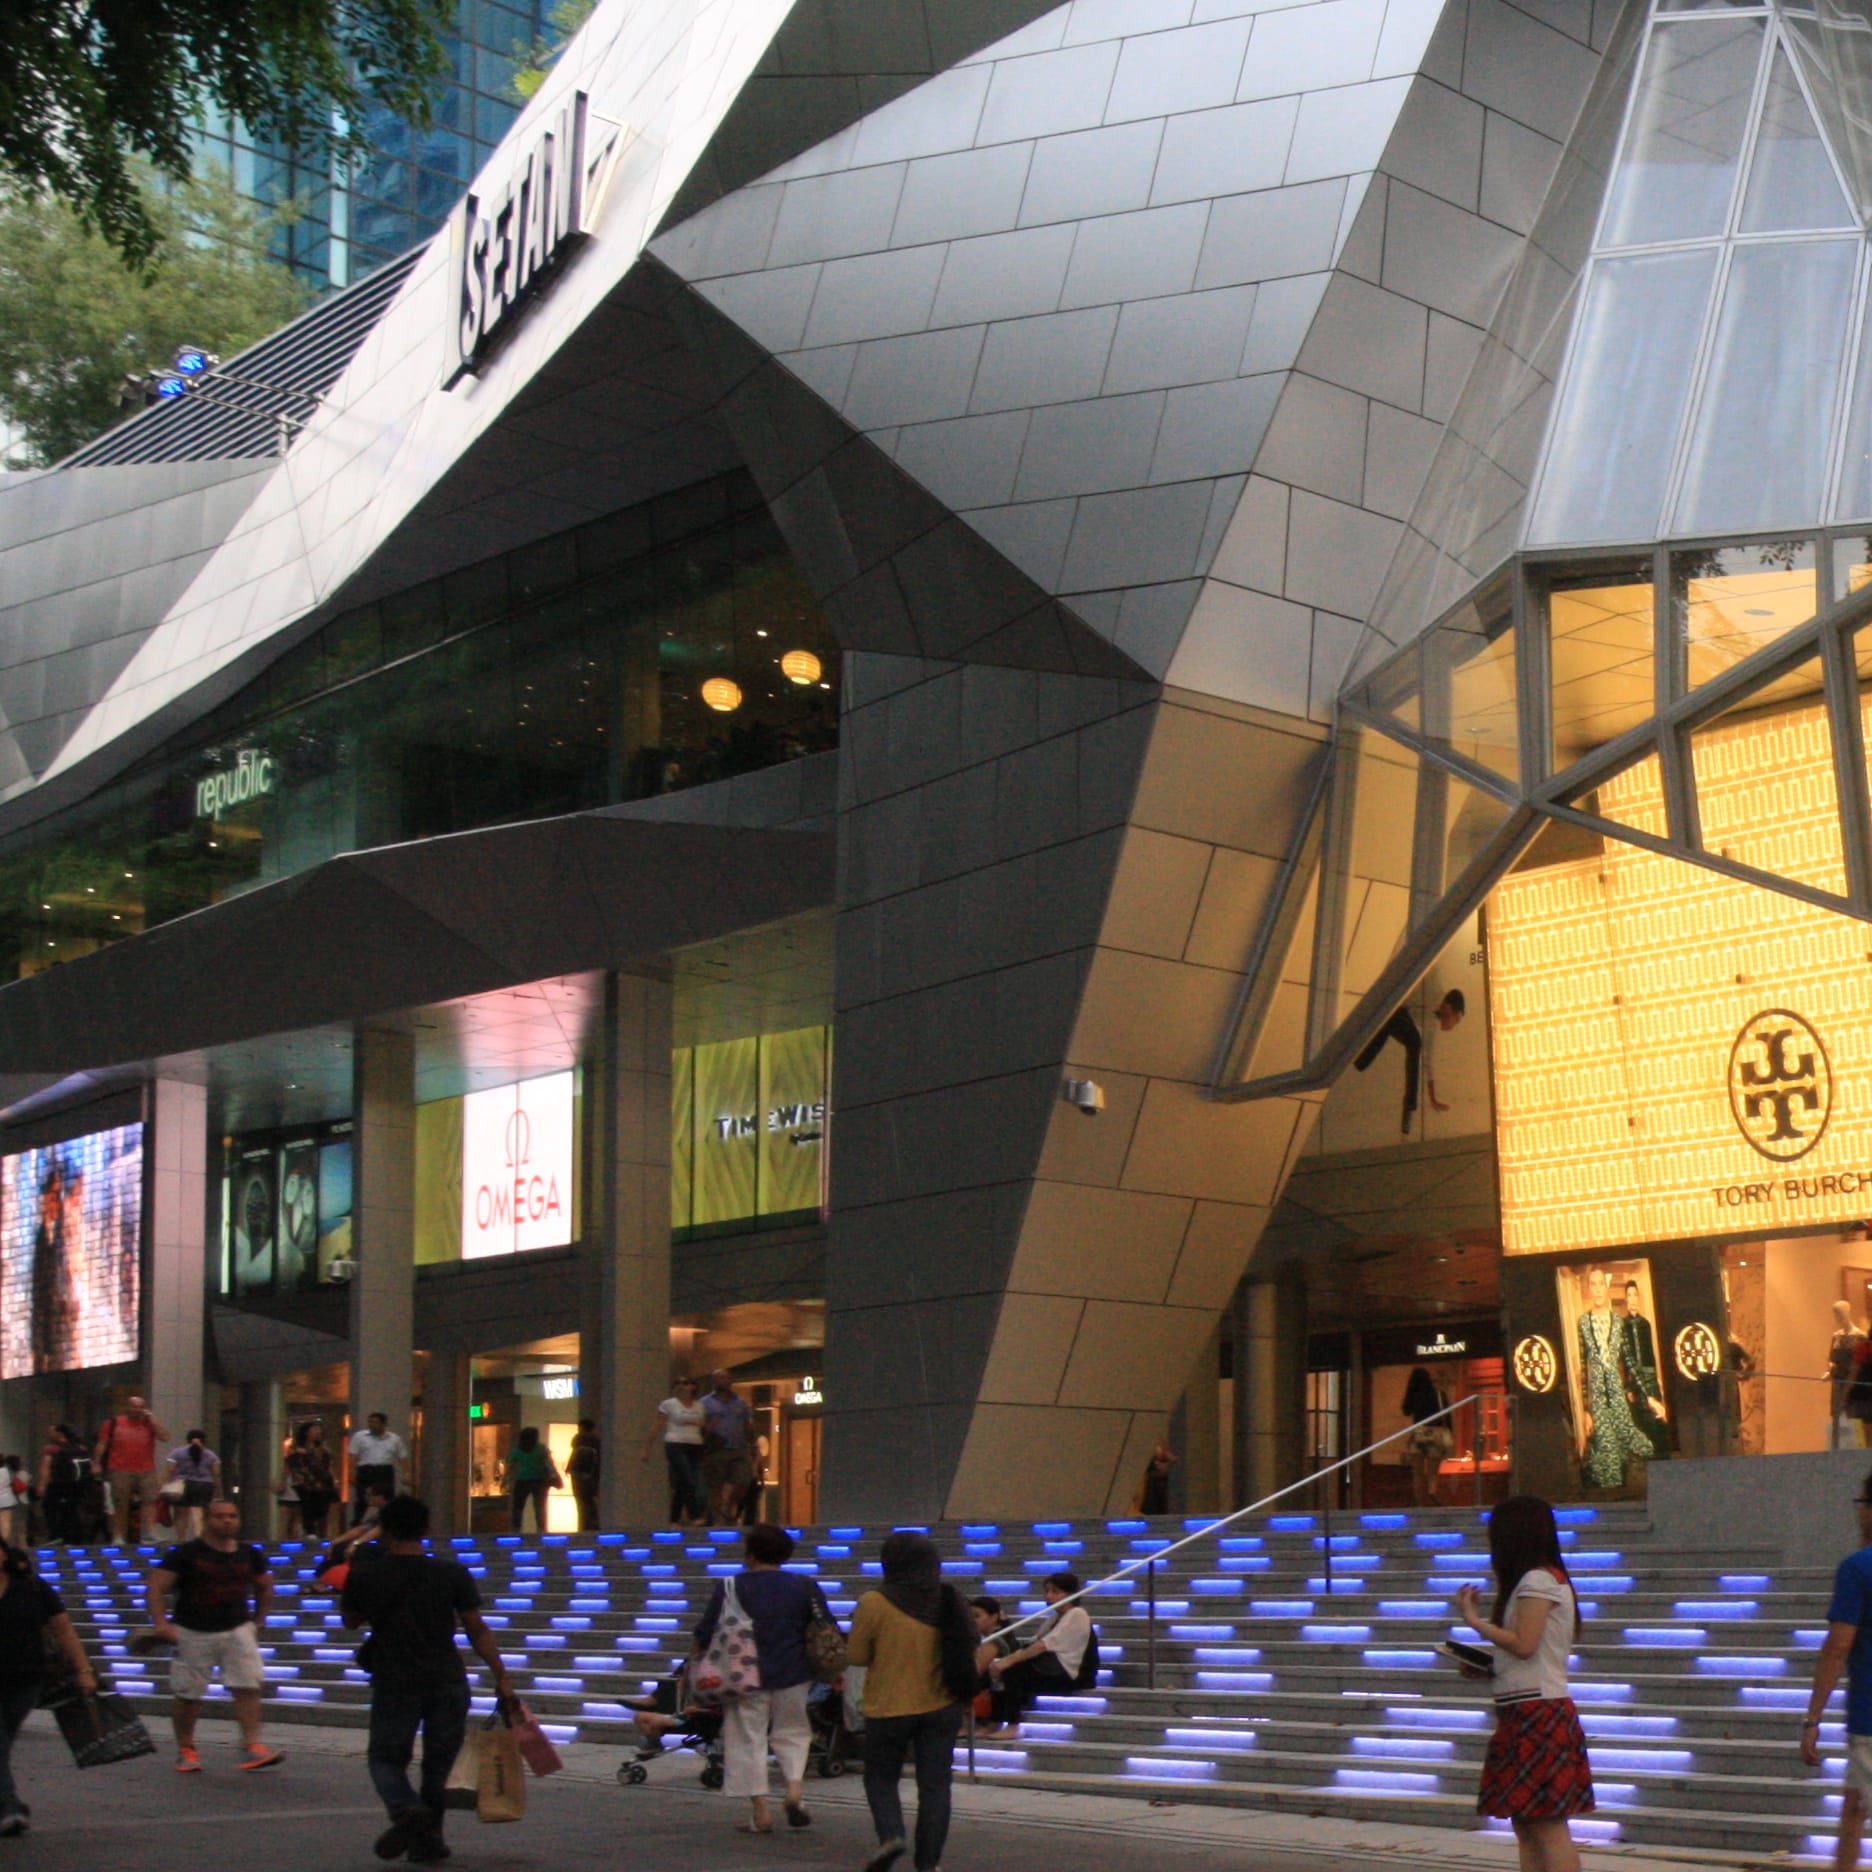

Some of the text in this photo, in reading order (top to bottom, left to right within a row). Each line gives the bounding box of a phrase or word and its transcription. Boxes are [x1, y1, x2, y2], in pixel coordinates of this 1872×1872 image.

[197, 749, 272, 820] republic
[713, 1103, 825, 1140] TIMEWIS
[476, 1172, 562, 1230] OMEGA
[1712, 1182, 1775, 1208] TORY
